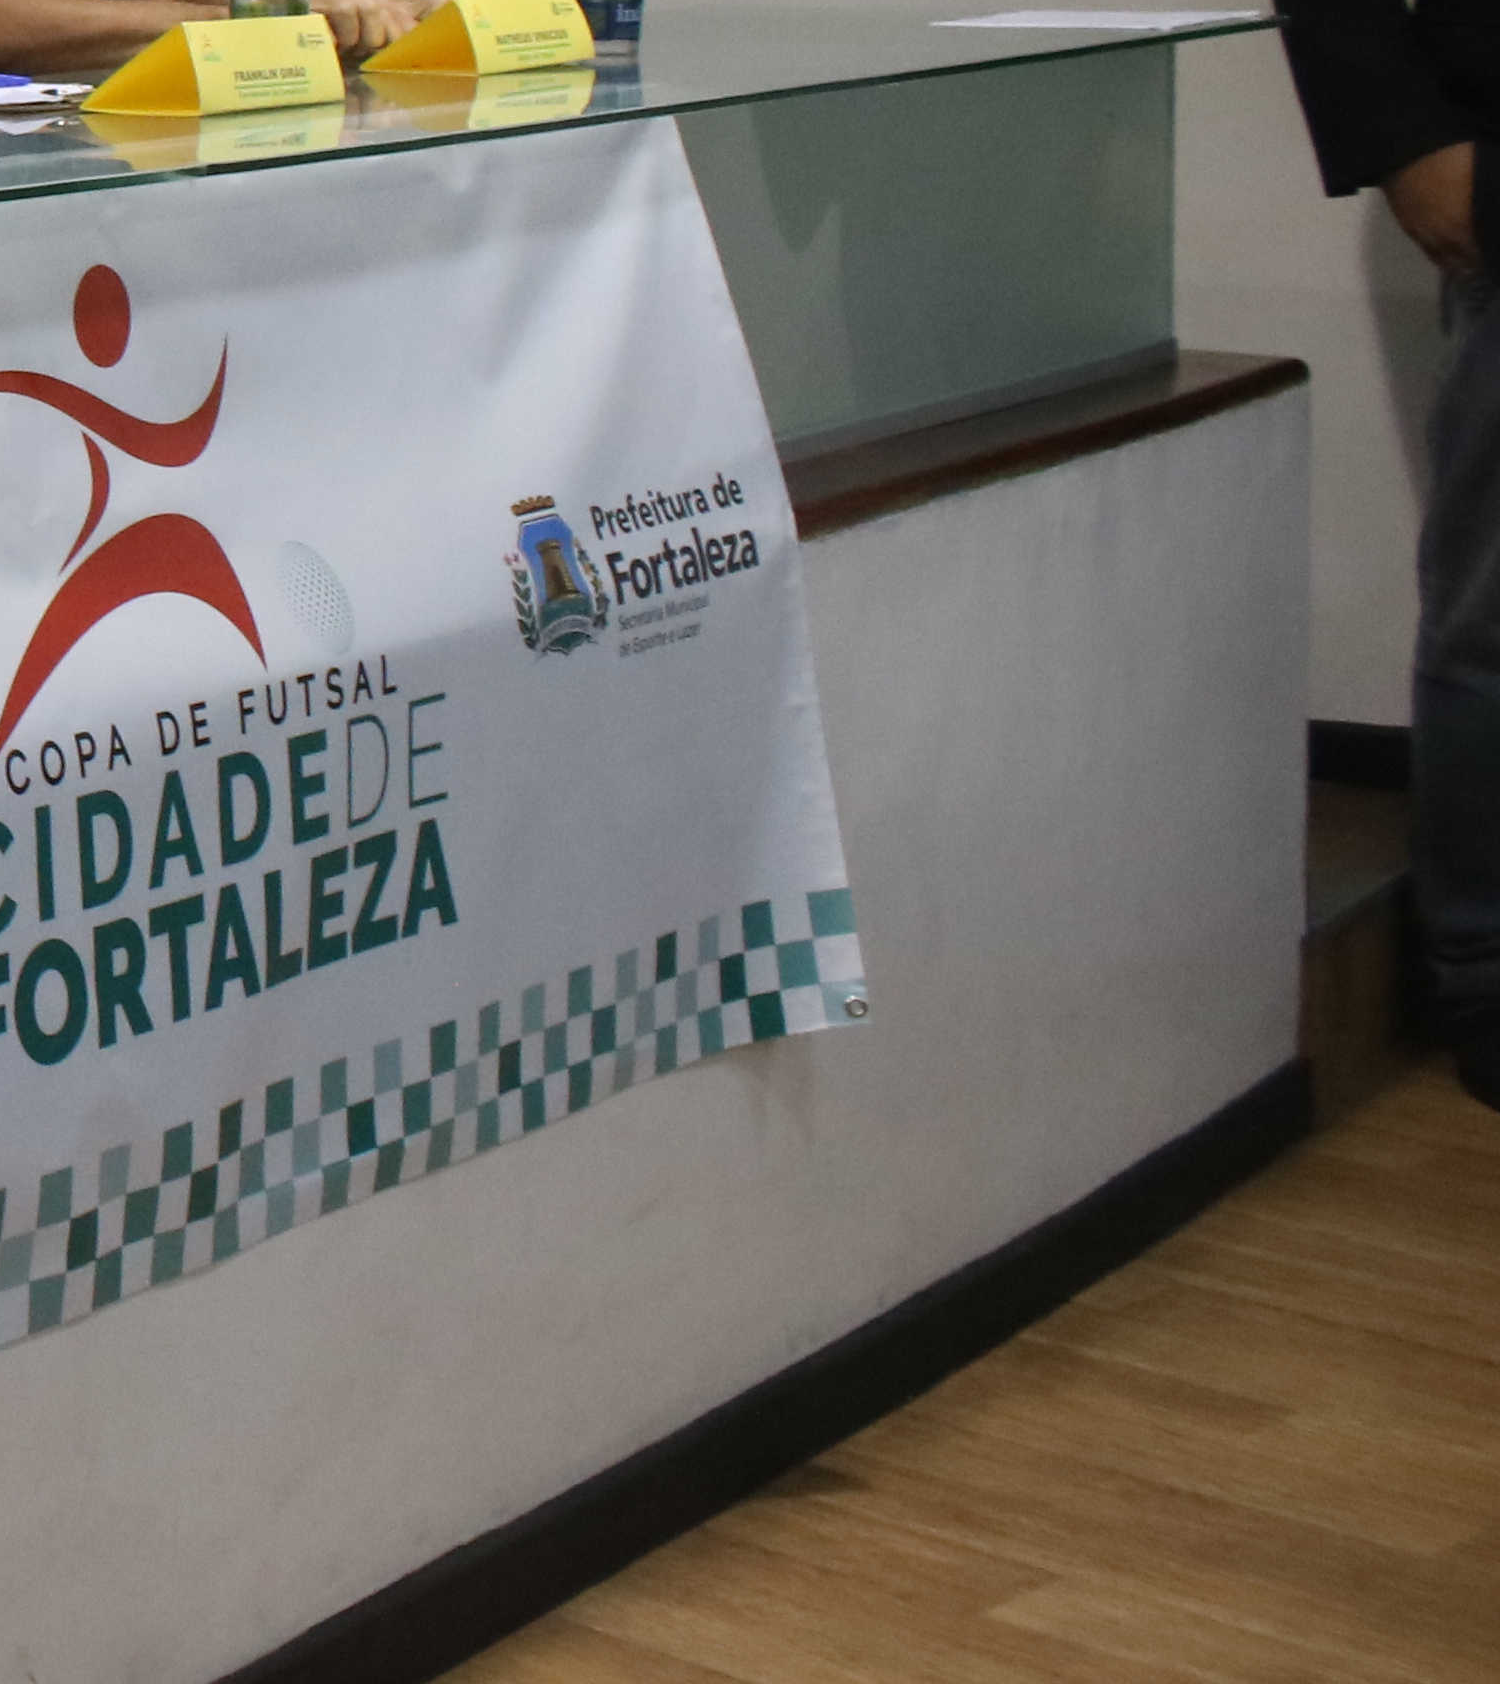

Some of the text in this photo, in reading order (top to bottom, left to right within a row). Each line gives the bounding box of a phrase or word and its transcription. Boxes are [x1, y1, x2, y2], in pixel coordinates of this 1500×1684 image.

[590, 472, 744, 540] Prefeitura de
[605, 526, 760, 606] Fortaleza
[5, 653, 398, 796] COPA DE FUTSAL
[346, 692, 449, 831] DE
